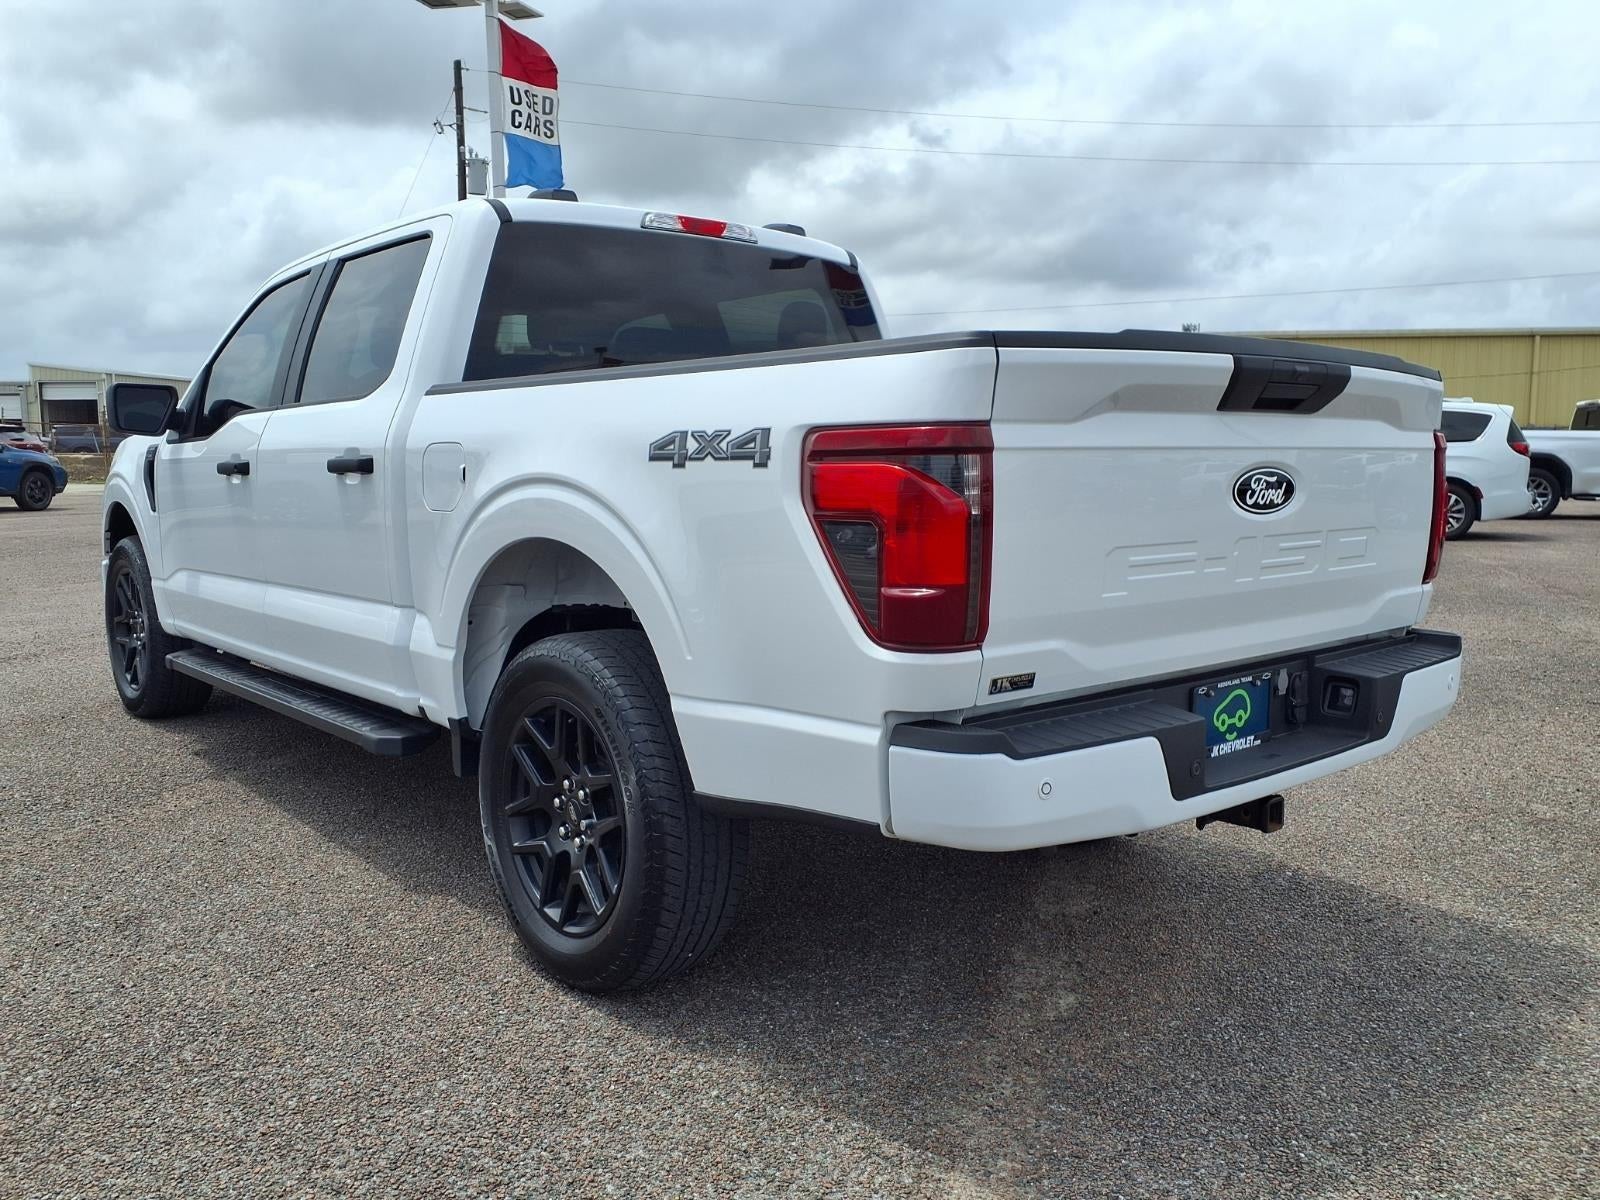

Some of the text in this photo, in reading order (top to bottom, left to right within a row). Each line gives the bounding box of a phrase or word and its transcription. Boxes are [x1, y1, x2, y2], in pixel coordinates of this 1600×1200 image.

[509, 85, 554, 116] USED
[511, 109, 554, 139] CARS
[648, 427, 771, 469] 4X4
[1245, 473, 1287, 506] Ford
[1210, 744, 1219, 758] JK
